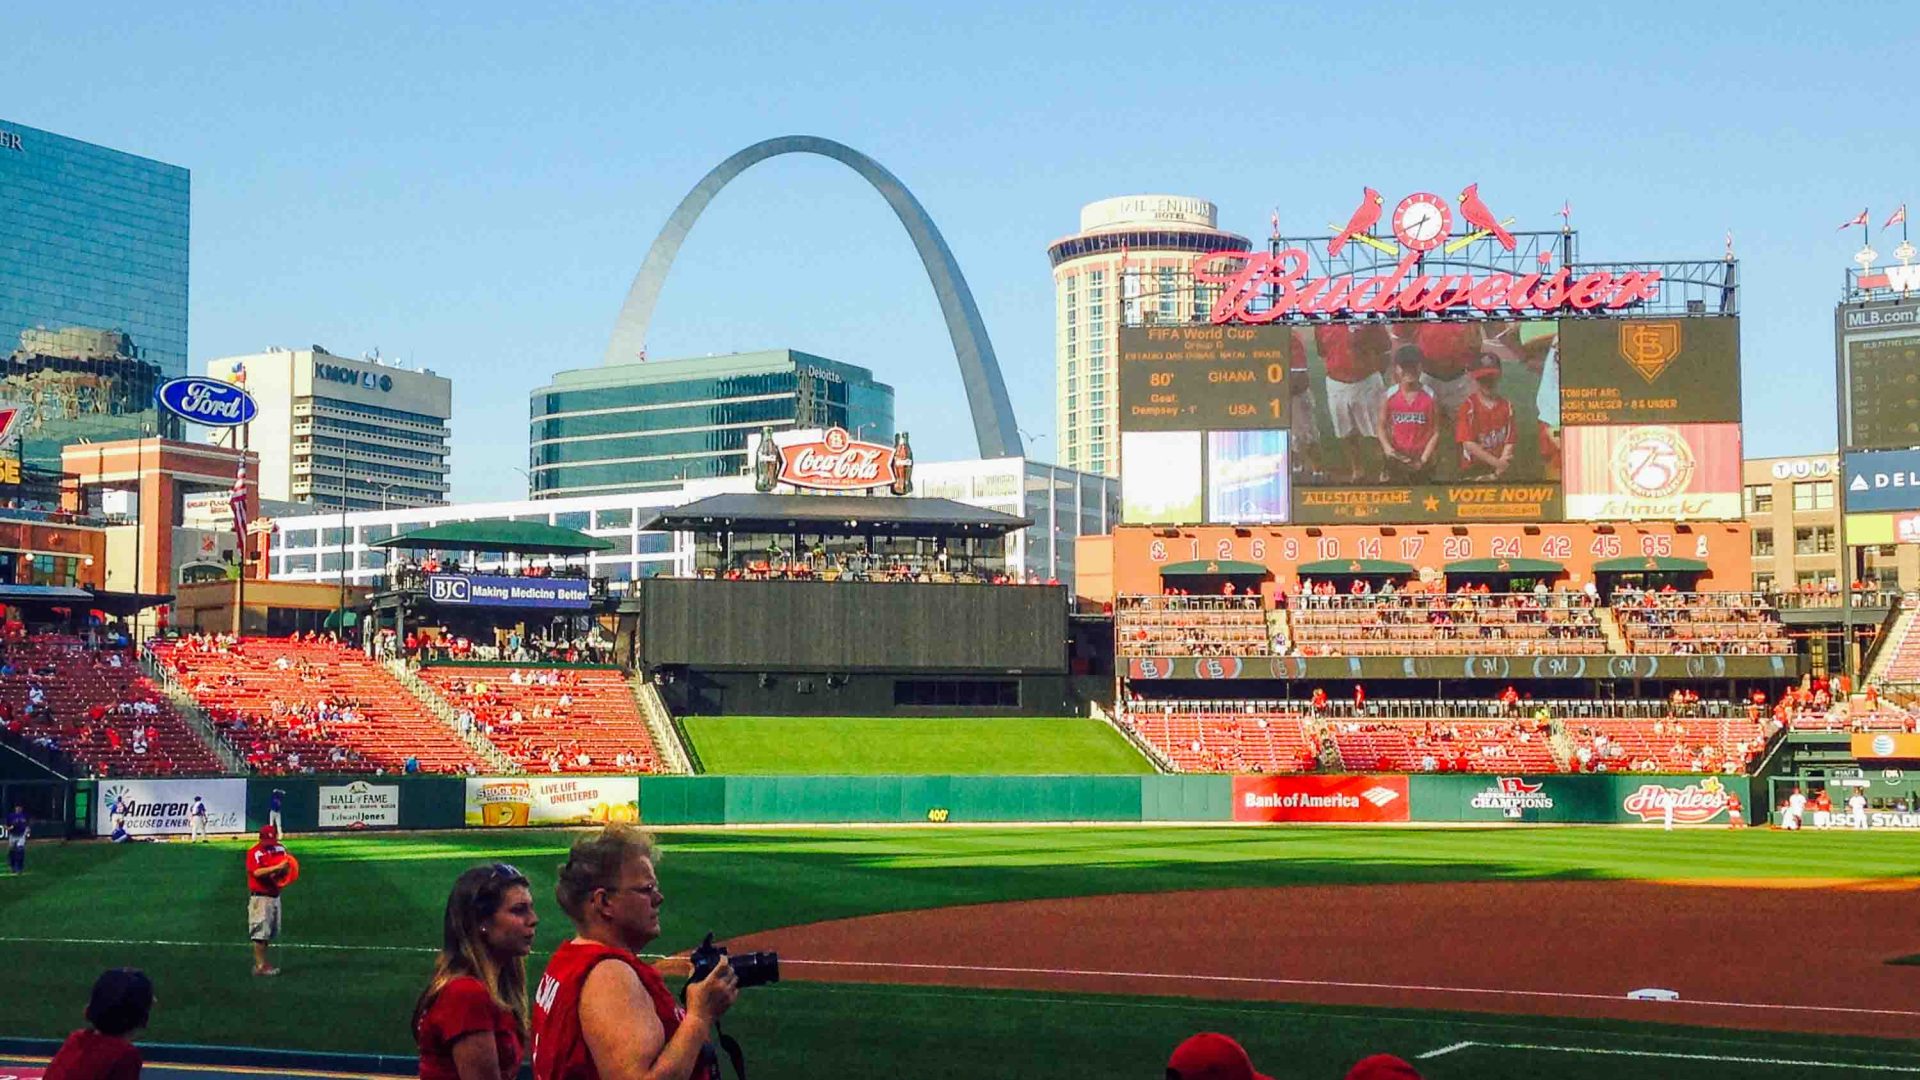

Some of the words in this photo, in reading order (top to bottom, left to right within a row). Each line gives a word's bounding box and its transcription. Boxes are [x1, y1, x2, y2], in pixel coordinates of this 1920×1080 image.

[1154, 211, 1186, 219] HOTEL
[1194, 250, 1660, 324] Budweiser
[1848, 310, 1914, 326] MLB.com
[1148, 329, 1180, 339] FIFA
[1184, 327, 1223, 339] World
[1227, 326, 1257, 340] Cup:
[315, 362, 359, 385] KMOV
[1208, 371, 1256, 383] GHANA
[1266, 363, 1284, 384] 0
[181, 382, 241, 418] Ford
[1131, 406, 1179, 416] Dempsey
[1228, 404, 1257, 416] USA
[1268, 398, 1281, 419] 1
[1449, 488, 1497, 502] VOTE
[1501, 488, 1553, 502] NOW!
[1191, 539, 1199, 561] 1
[1217, 539, 1233, 560] 2
[1252, 539, 1265, 560] 6
[1284, 538, 1300, 560] 9
[1317, 537, 1340, 559] 10
[1359, 537, 1382, 560] 14
[1400, 536, 1424, 559] 17
[1444, 537, 1472, 560] 20
[1542, 536, 1571, 558] 42
[1591, 536, 1622, 558] 45
[435, 580, 466, 599] BJC
[472, 585, 509, 600] Making
[511, 586, 556, 600] Medicine
[557, 588, 588, 601] Better
[541, 785, 559, 795] LIVE
[560, 782, 577, 792] LIFE
[330, 795, 355, 803] HALL
[363, 794, 388, 803] FAME
[550, 790, 599, 805] UNFILTERED
[1245, 793, 1282, 807] Bank
[1283, 793, 1297, 807] of
[1300, 793, 1359, 807] America
[1471, 798, 1553, 808] CHAMPIONS
[124, 800, 189, 817] Ameren
[126, 819, 163, 829] OCUSED
[361, 813, 385, 821] Jones
